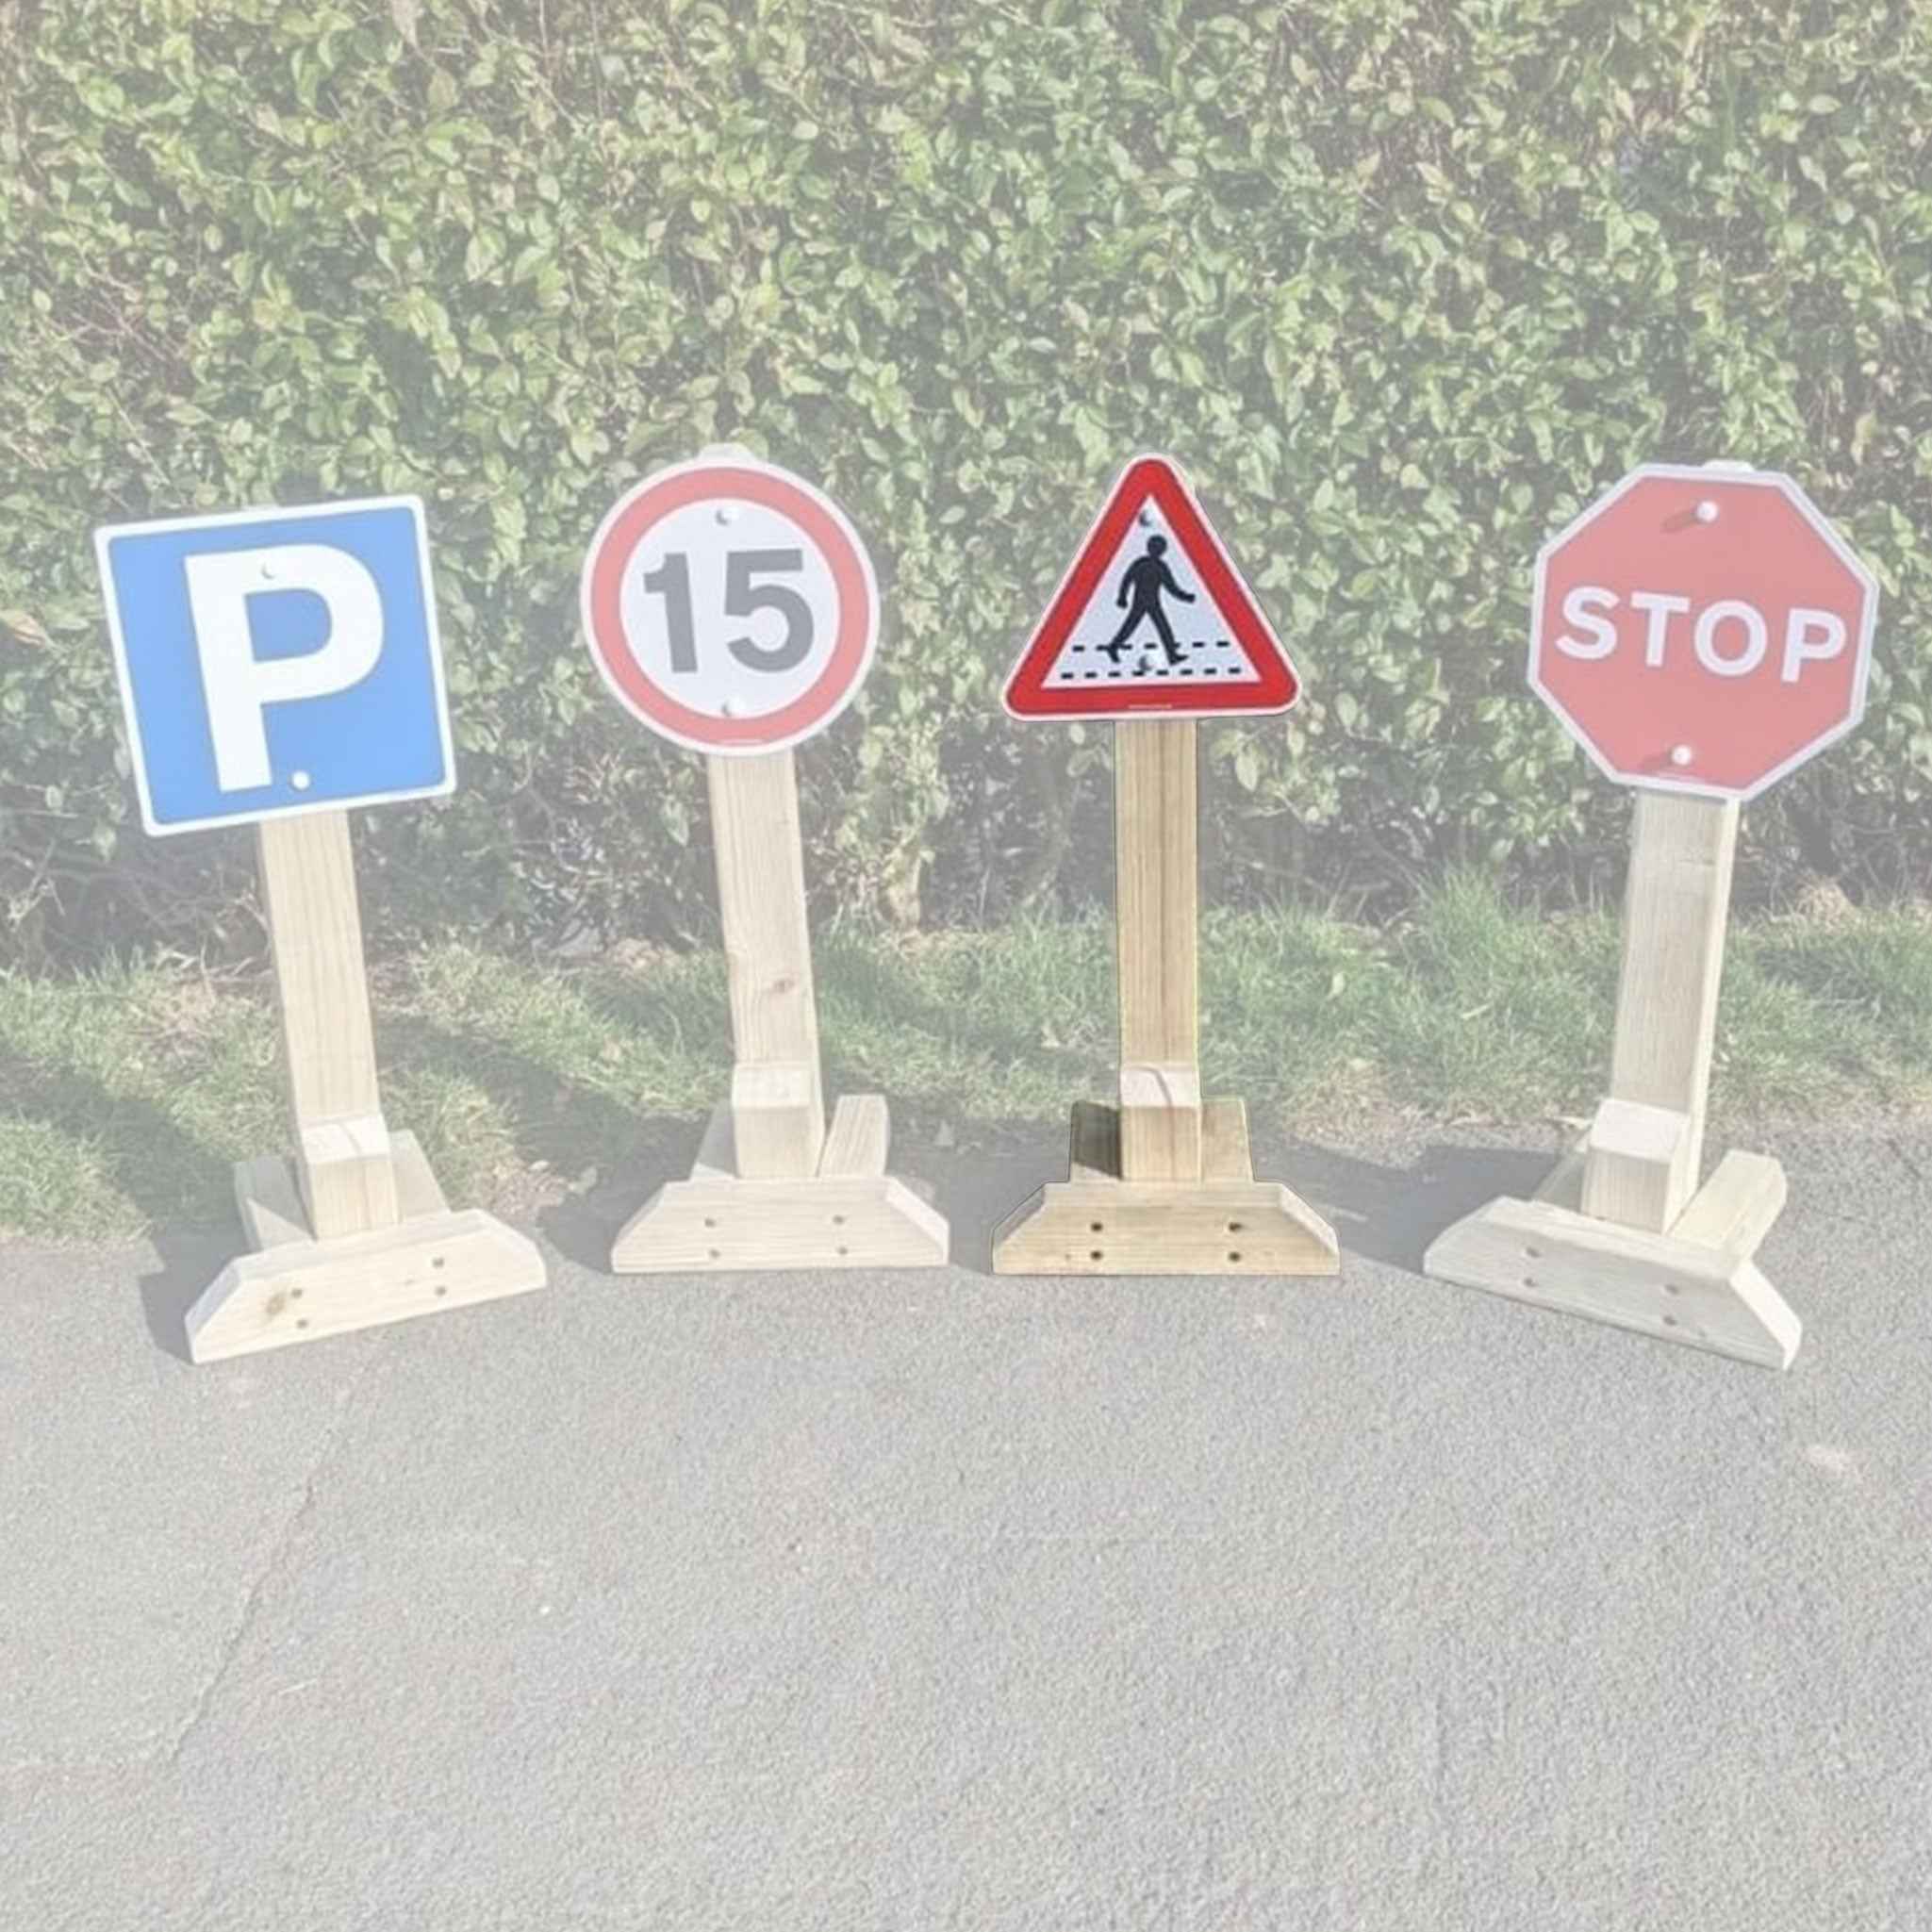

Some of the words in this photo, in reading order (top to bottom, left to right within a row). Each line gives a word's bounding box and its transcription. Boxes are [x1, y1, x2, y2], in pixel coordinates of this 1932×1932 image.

[184, 543, 385, 793] P
[643, 549, 815, 673] 15
[1555, 586, 1847, 684] STOP
